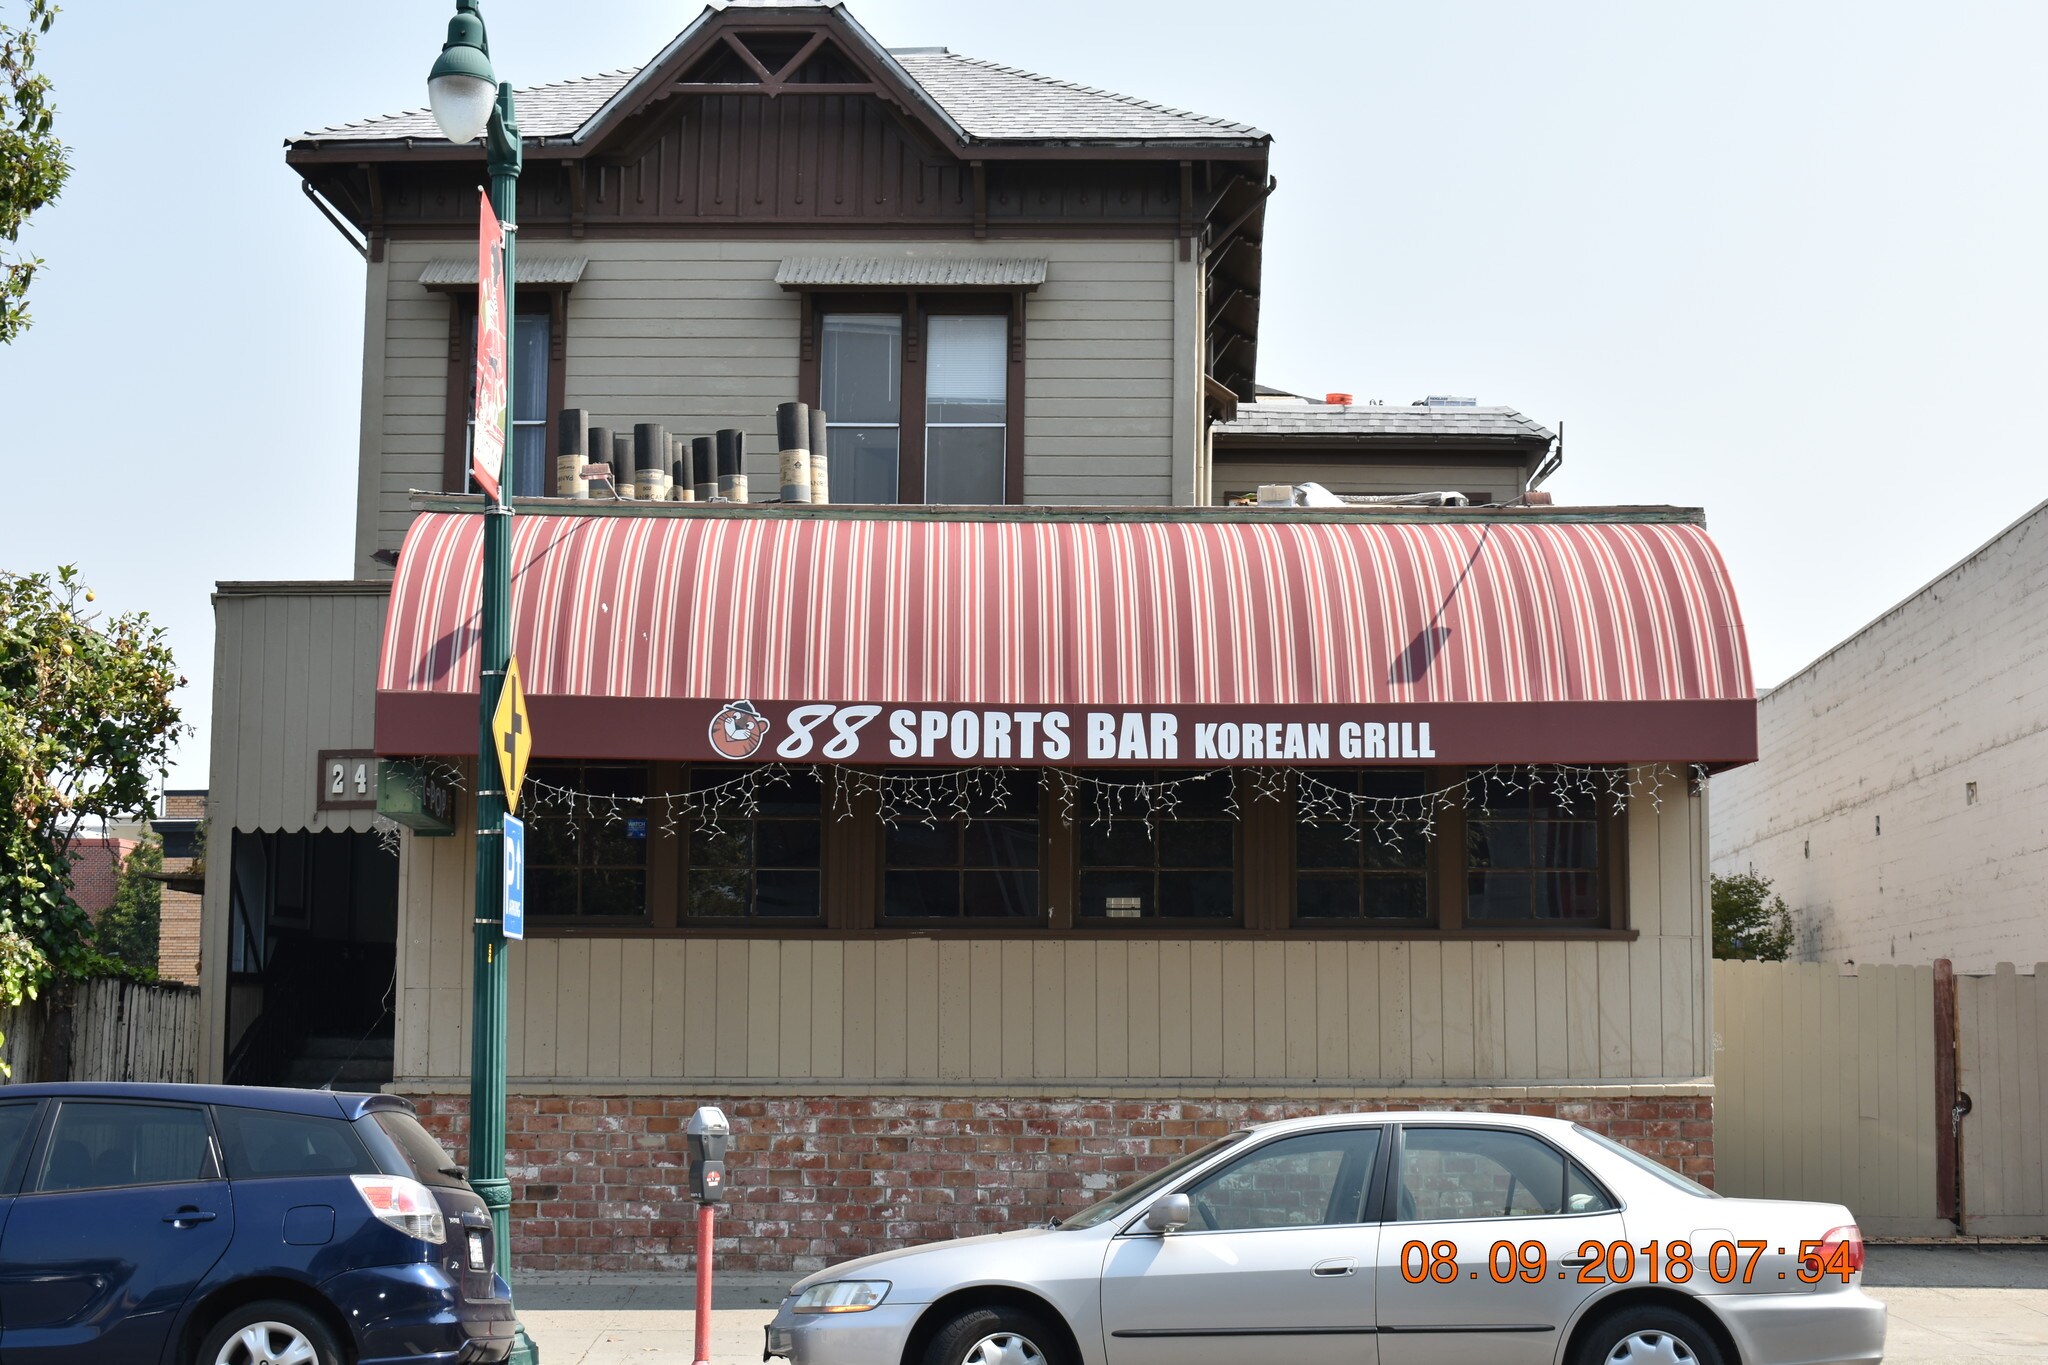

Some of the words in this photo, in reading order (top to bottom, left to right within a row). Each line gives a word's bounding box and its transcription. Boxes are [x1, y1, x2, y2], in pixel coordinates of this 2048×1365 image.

[776, 704, 883, 759] 88
[888, 709, 1071, 759] SPORTS
[1087, 712, 1178, 760] BAR
[1195, 722, 1330, 760] KOREAN
[1339, 721, 1436, 759] GRILL
